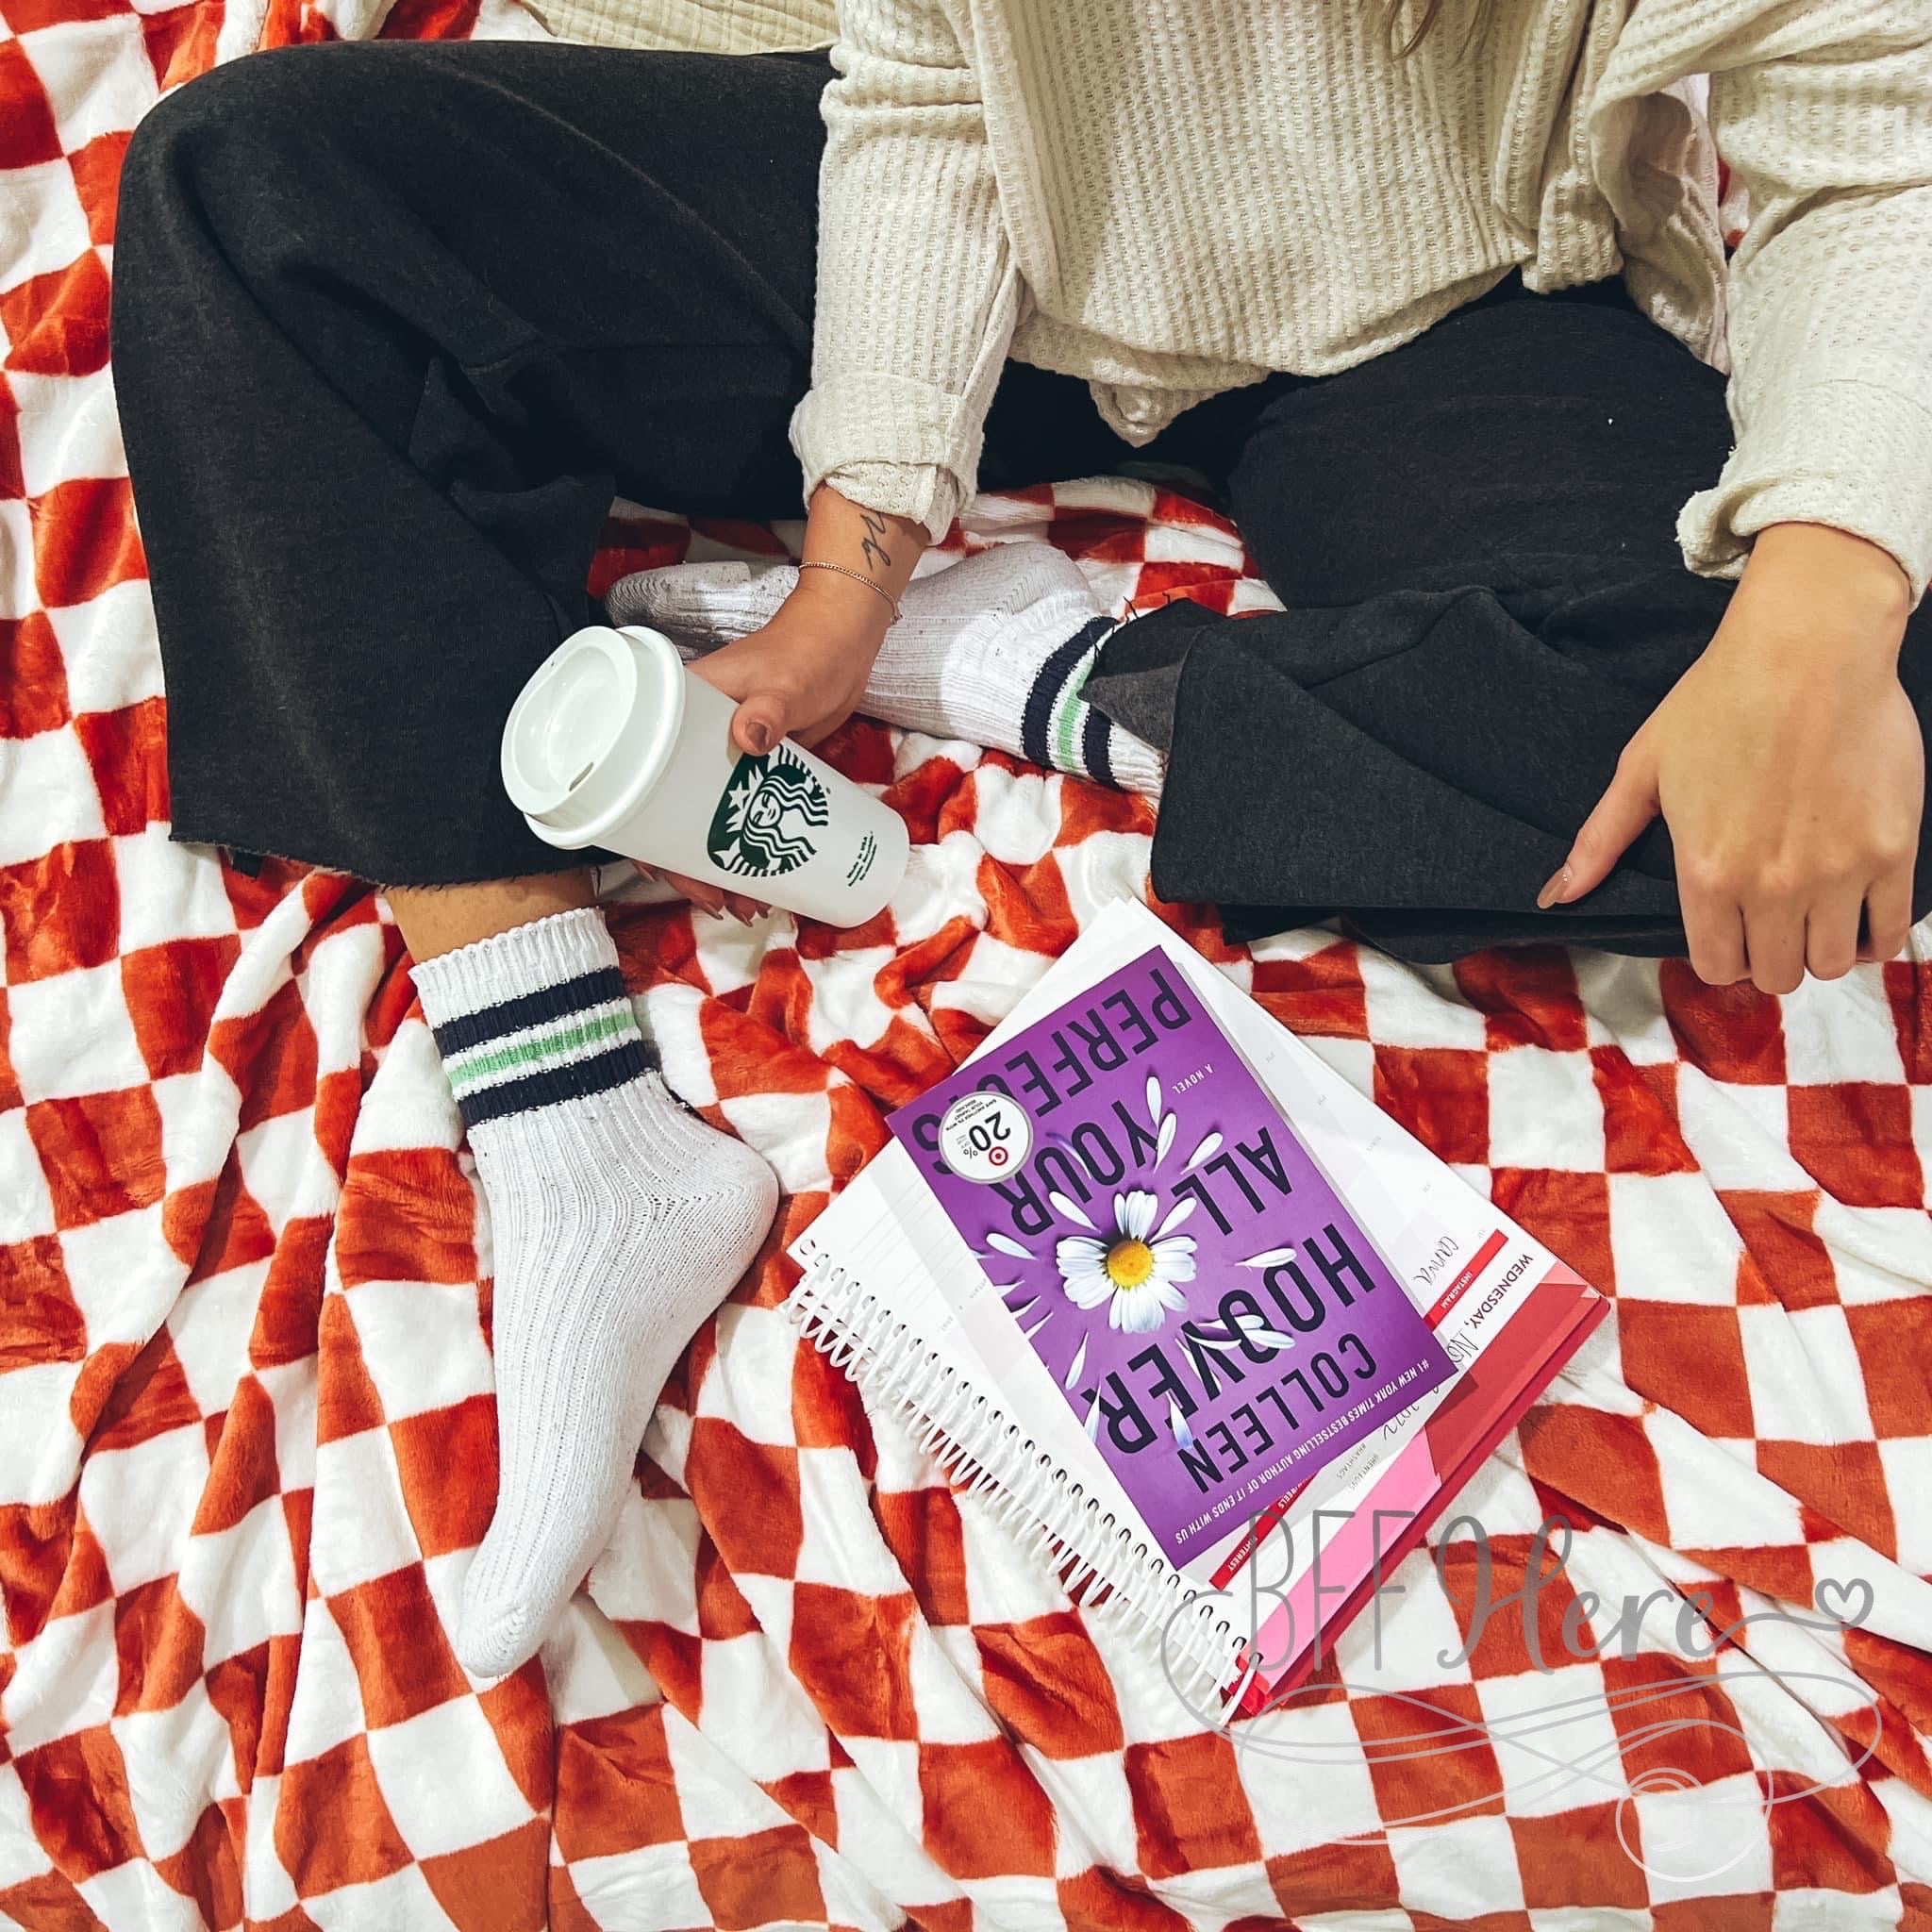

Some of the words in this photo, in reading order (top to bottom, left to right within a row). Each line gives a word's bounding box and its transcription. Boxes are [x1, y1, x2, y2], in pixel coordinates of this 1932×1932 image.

[911, 969, 1192, 1175] PERFES
[1204, 1063, 1214, 1074] A
[1172, 1069, 1205, 1094] NOVEL
[988, 1101, 1160, 1236] YOUR
[1171, 1127, 1293, 1236] ALL
[1441, 1271, 1474, 1309] INSTAGRAM
[1463, 1254, 1534, 1330] WEDNESDAY,
[1081, 1224, 1376, 1454] HOOVER
[1398, 1367, 1418, 1388] NEW
[1416, 1358, 1430, 1373] #1
[1374, 1381, 1398, 1403] YORK
[1178, 1333, 1377, 1493] COLLEEN
[1347, 1397, 1374, 1422] TIMES
[1292, 1415, 1349, 1460] BESTSELLING
[1257, 1454, 1293, 1484] AUTHOR
[1236, 1488, 1246, 1502] IT
[1247, 1479, 1259, 1493] OF
[1212, 1494, 1236, 1518] ENDS
[1175, 1528, 1189, 1544] US
[1188, 1512, 1212, 1535] WITH
[1227, 1534, 1258, 1572] PINTEREST
